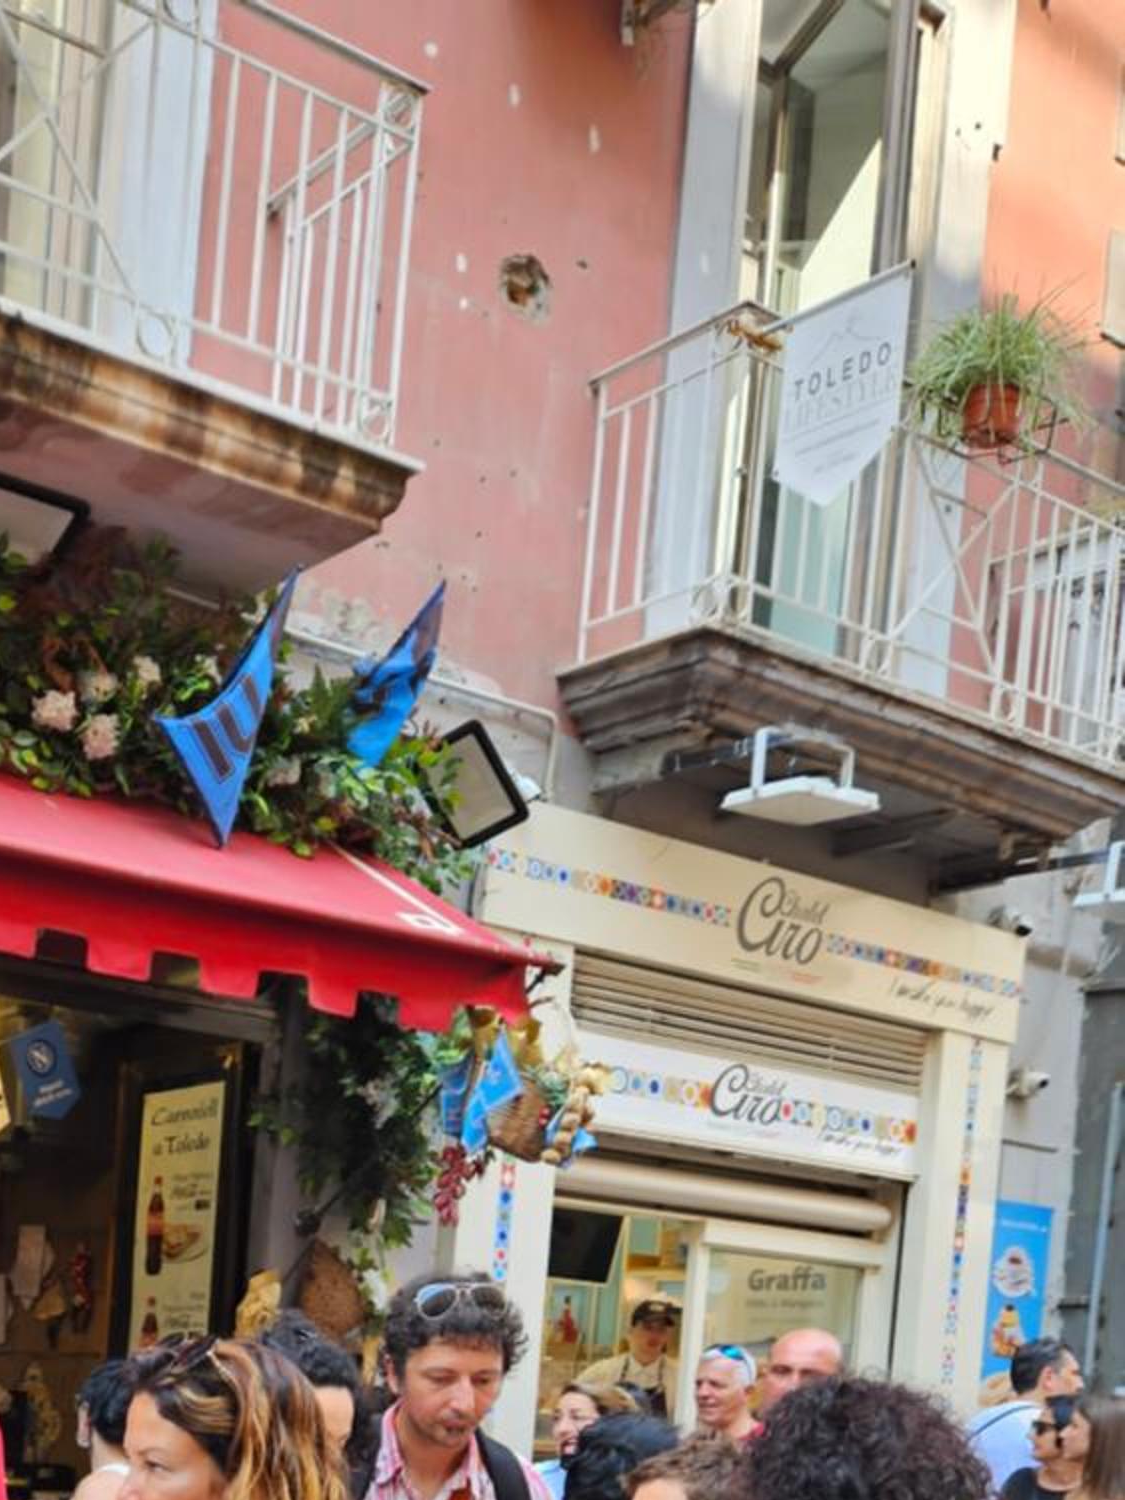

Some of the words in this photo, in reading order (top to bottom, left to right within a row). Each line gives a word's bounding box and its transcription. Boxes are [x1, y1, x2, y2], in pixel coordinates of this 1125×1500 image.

[794, 341, 891, 401] TOLEDO
[737, 876, 823, 966] Ciro
[709, 1063, 781, 1126] Ciro
[747, 1265, 827, 1292] Graffa
